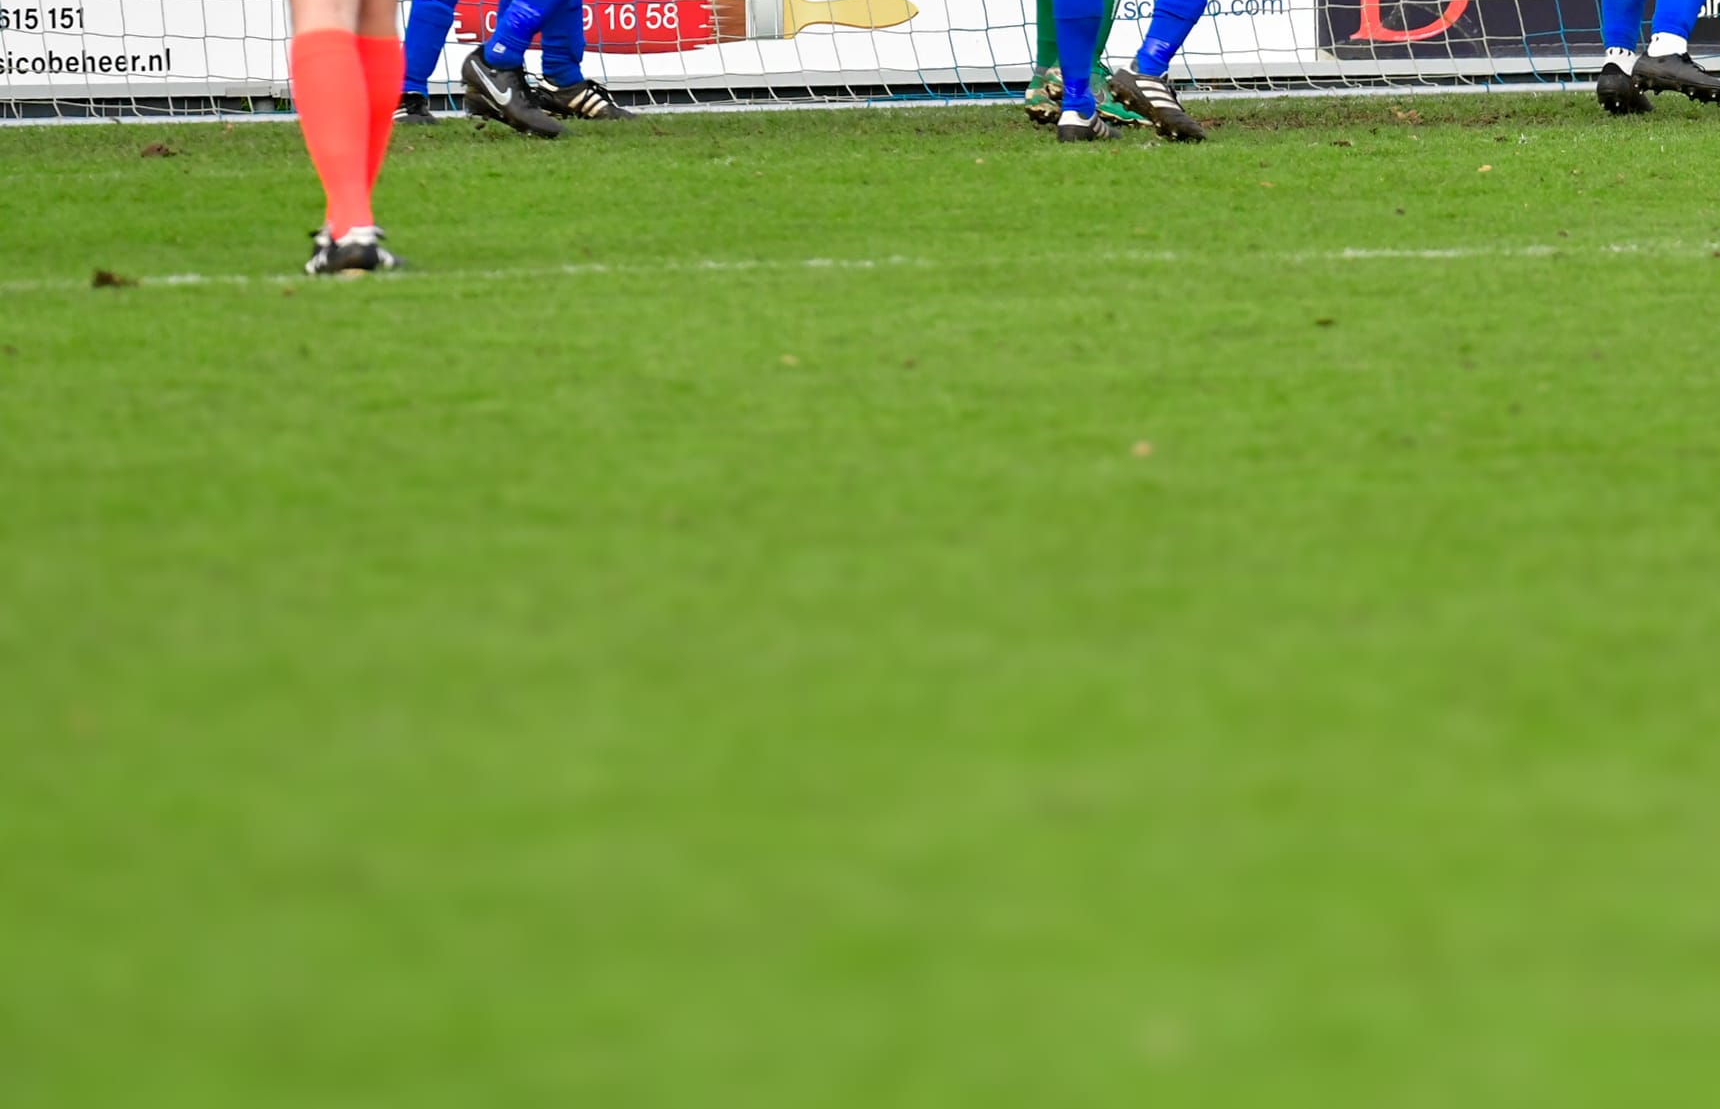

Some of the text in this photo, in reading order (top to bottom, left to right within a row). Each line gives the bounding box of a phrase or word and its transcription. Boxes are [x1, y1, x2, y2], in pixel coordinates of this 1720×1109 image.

[48, 8, 84, 29] 151
[604, 3, 635, 30] 16
[645, 3, 678, 30] 58
